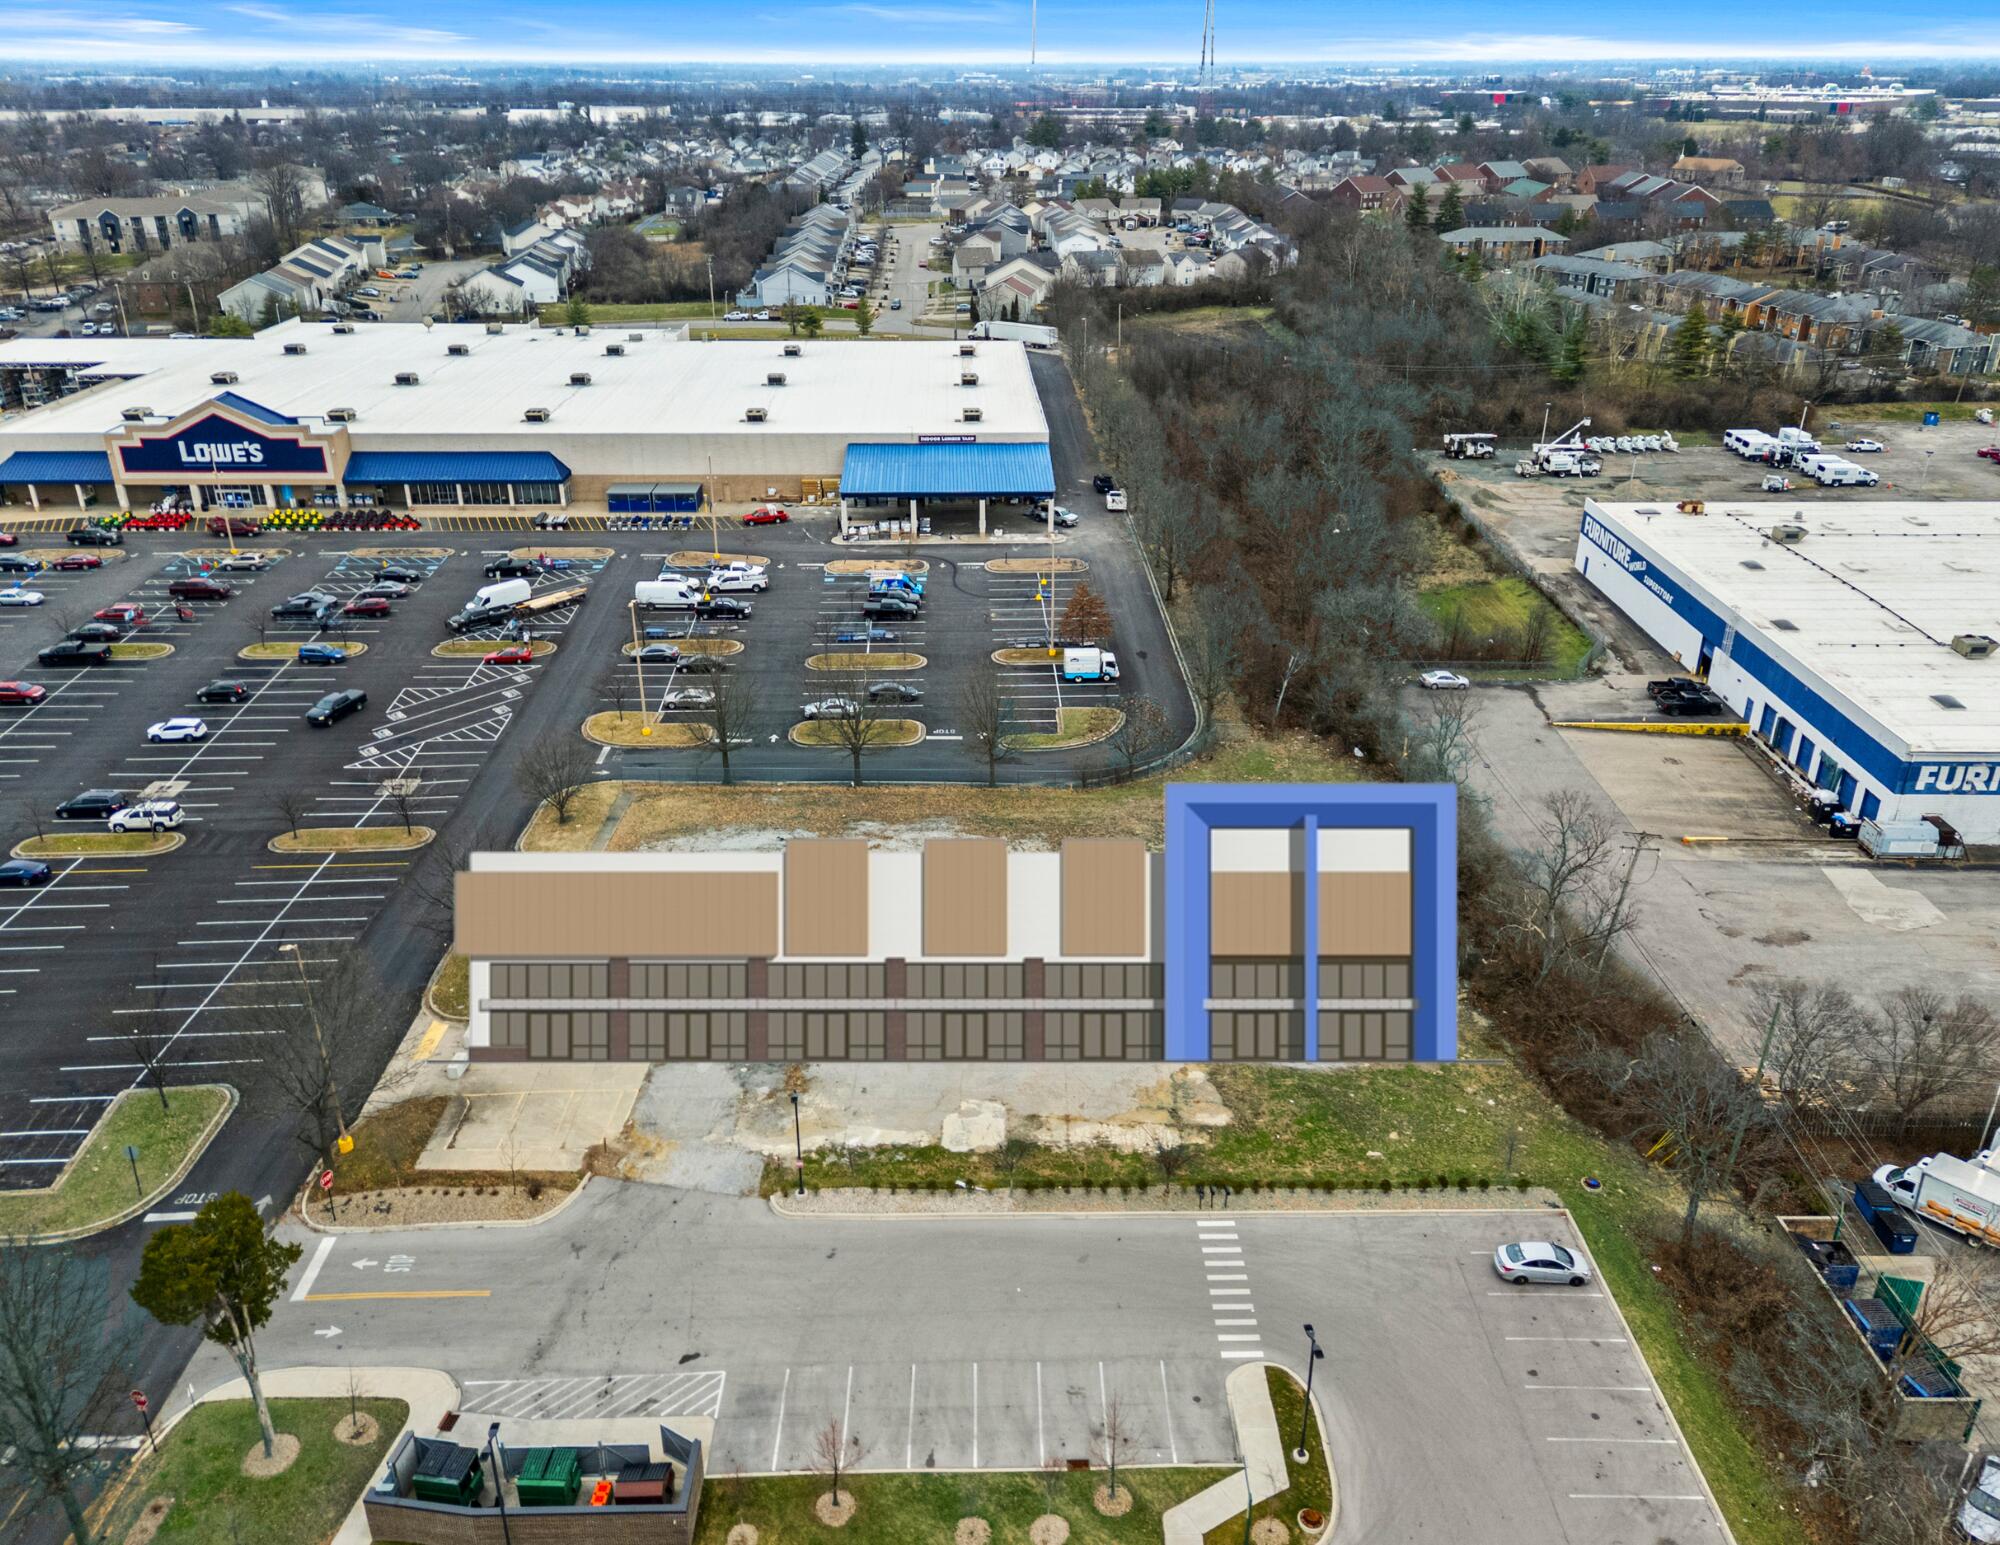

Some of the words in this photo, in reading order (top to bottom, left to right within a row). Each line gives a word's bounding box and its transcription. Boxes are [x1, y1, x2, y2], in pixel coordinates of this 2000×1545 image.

[178, 440, 264, 463] LOWE'S
[1583, 514, 1632, 569] FURNITURE
[1628, 561, 1647, 572] WORLD
[1643, 574, 1675, 605] SUPERSTORE
[383, 1254, 417, 1273] STOP
